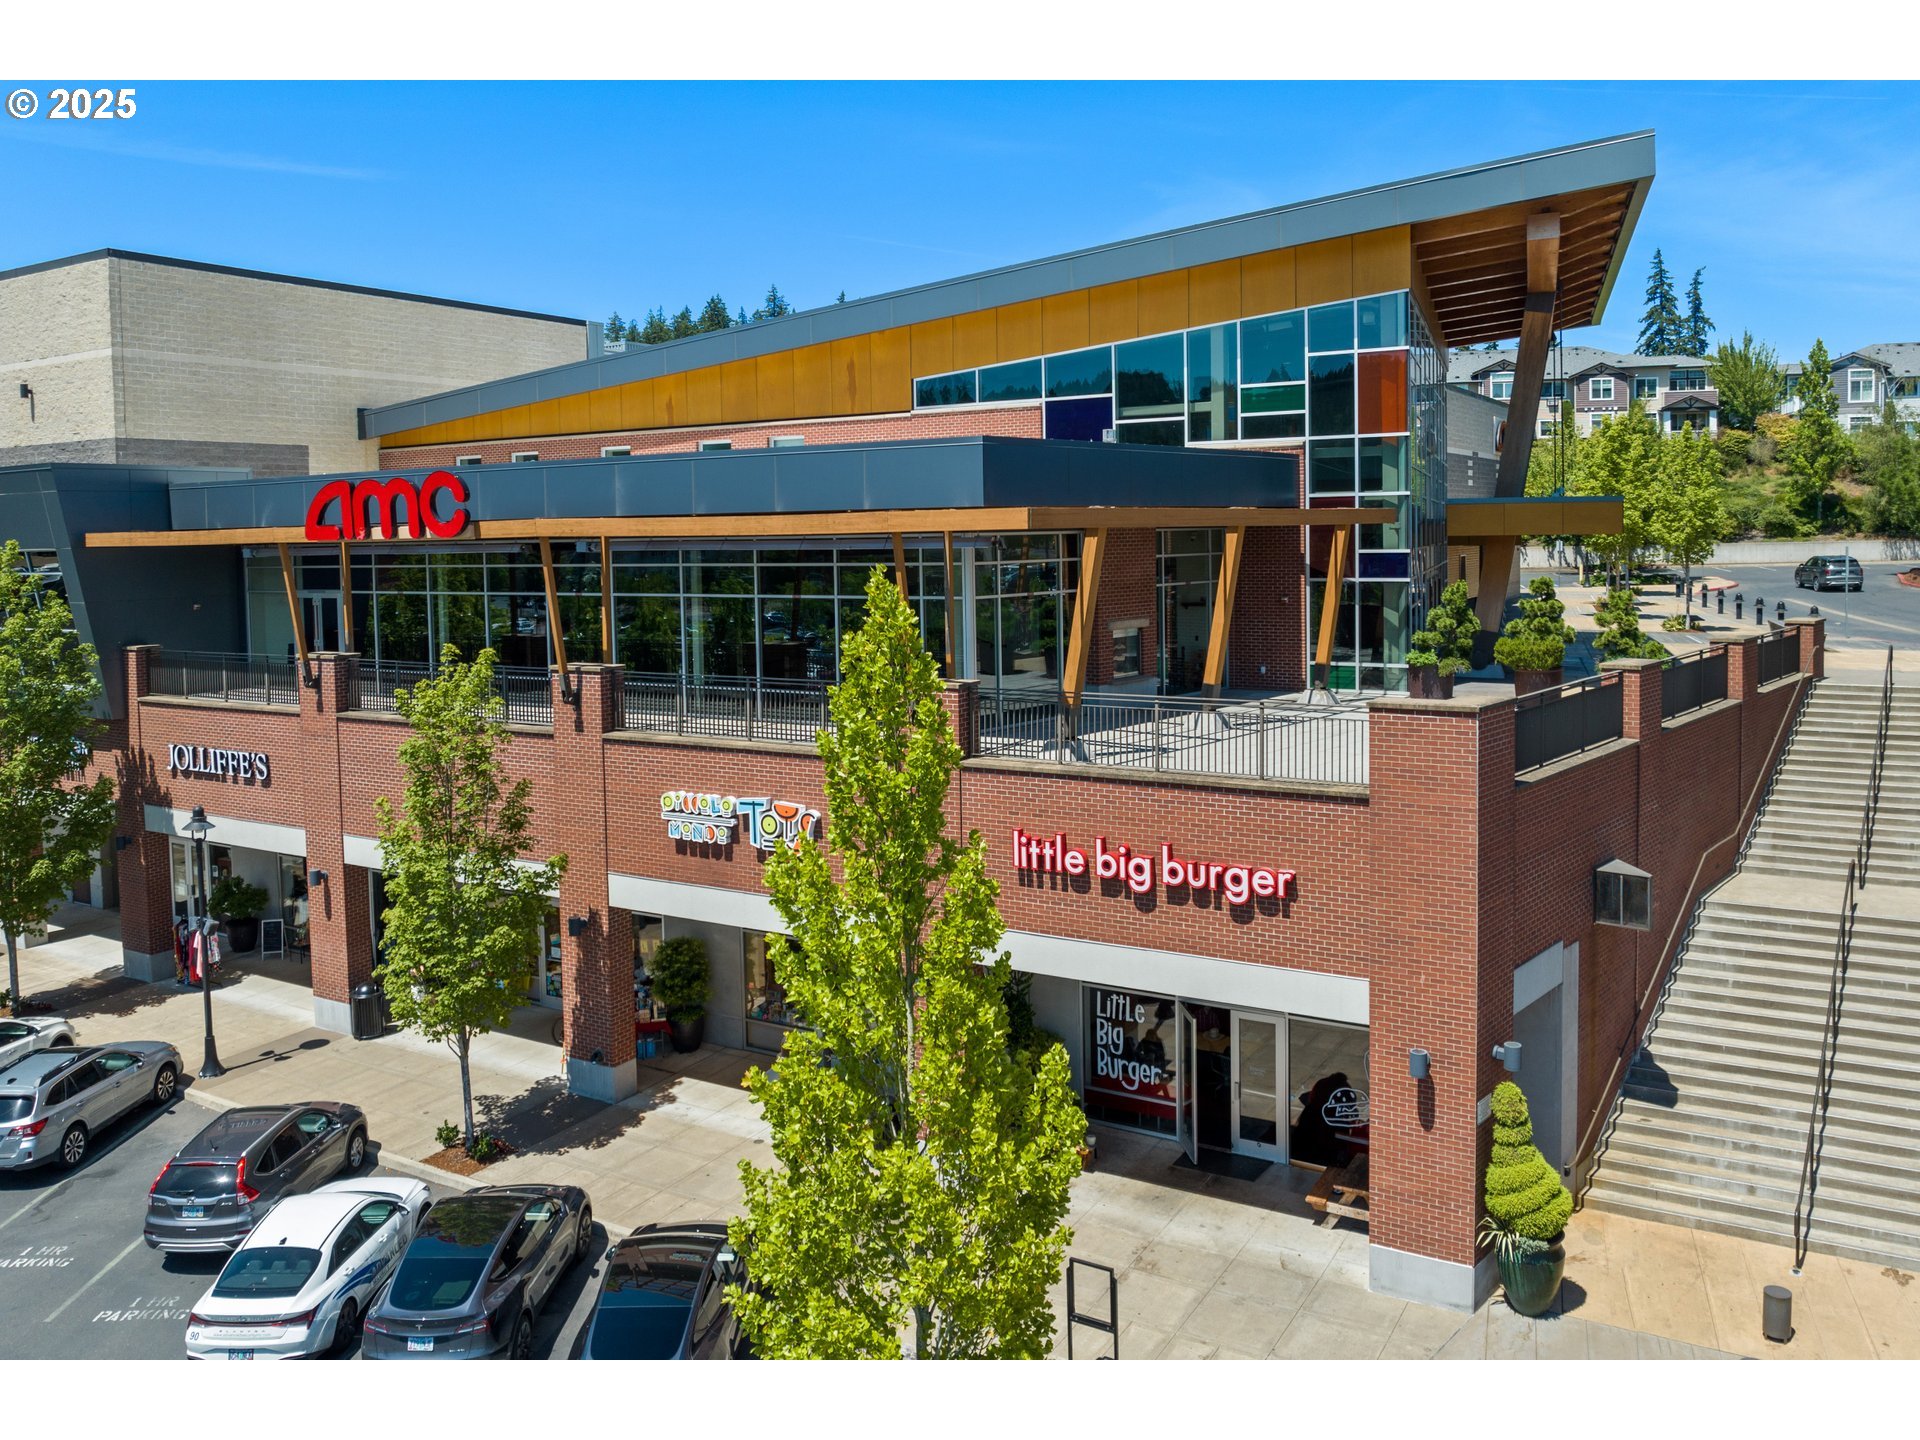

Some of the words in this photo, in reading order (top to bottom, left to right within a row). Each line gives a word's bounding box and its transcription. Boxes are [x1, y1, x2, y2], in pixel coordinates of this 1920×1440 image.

[305, 470, 471, 541] amc
[167, 744, 271, 780] JOLLIFFE'S
[661, 790, 737, 818] PICCOLO
[668, 820, 732, 845] MONDO
[1012, 827, 1088, 876] little
[1095, 836, 1155, 894] big
[1161, 842, 1296, 906] burger
[1096, 1017, 1124, 1056] Big
[1097, 1046, 1162, 1091] Burger
[0, 1257, 75, 1269] ARKING
[20, 1246, 33, 1256] 1
[36, 1245, 69, 1256] HR
[128, 1296, 143, 1308] 1
[147, 1296, 181, 1308] HR
[92, 1309, 190, 1322] PARKING
[189, 1331, 200, 1341] 90
